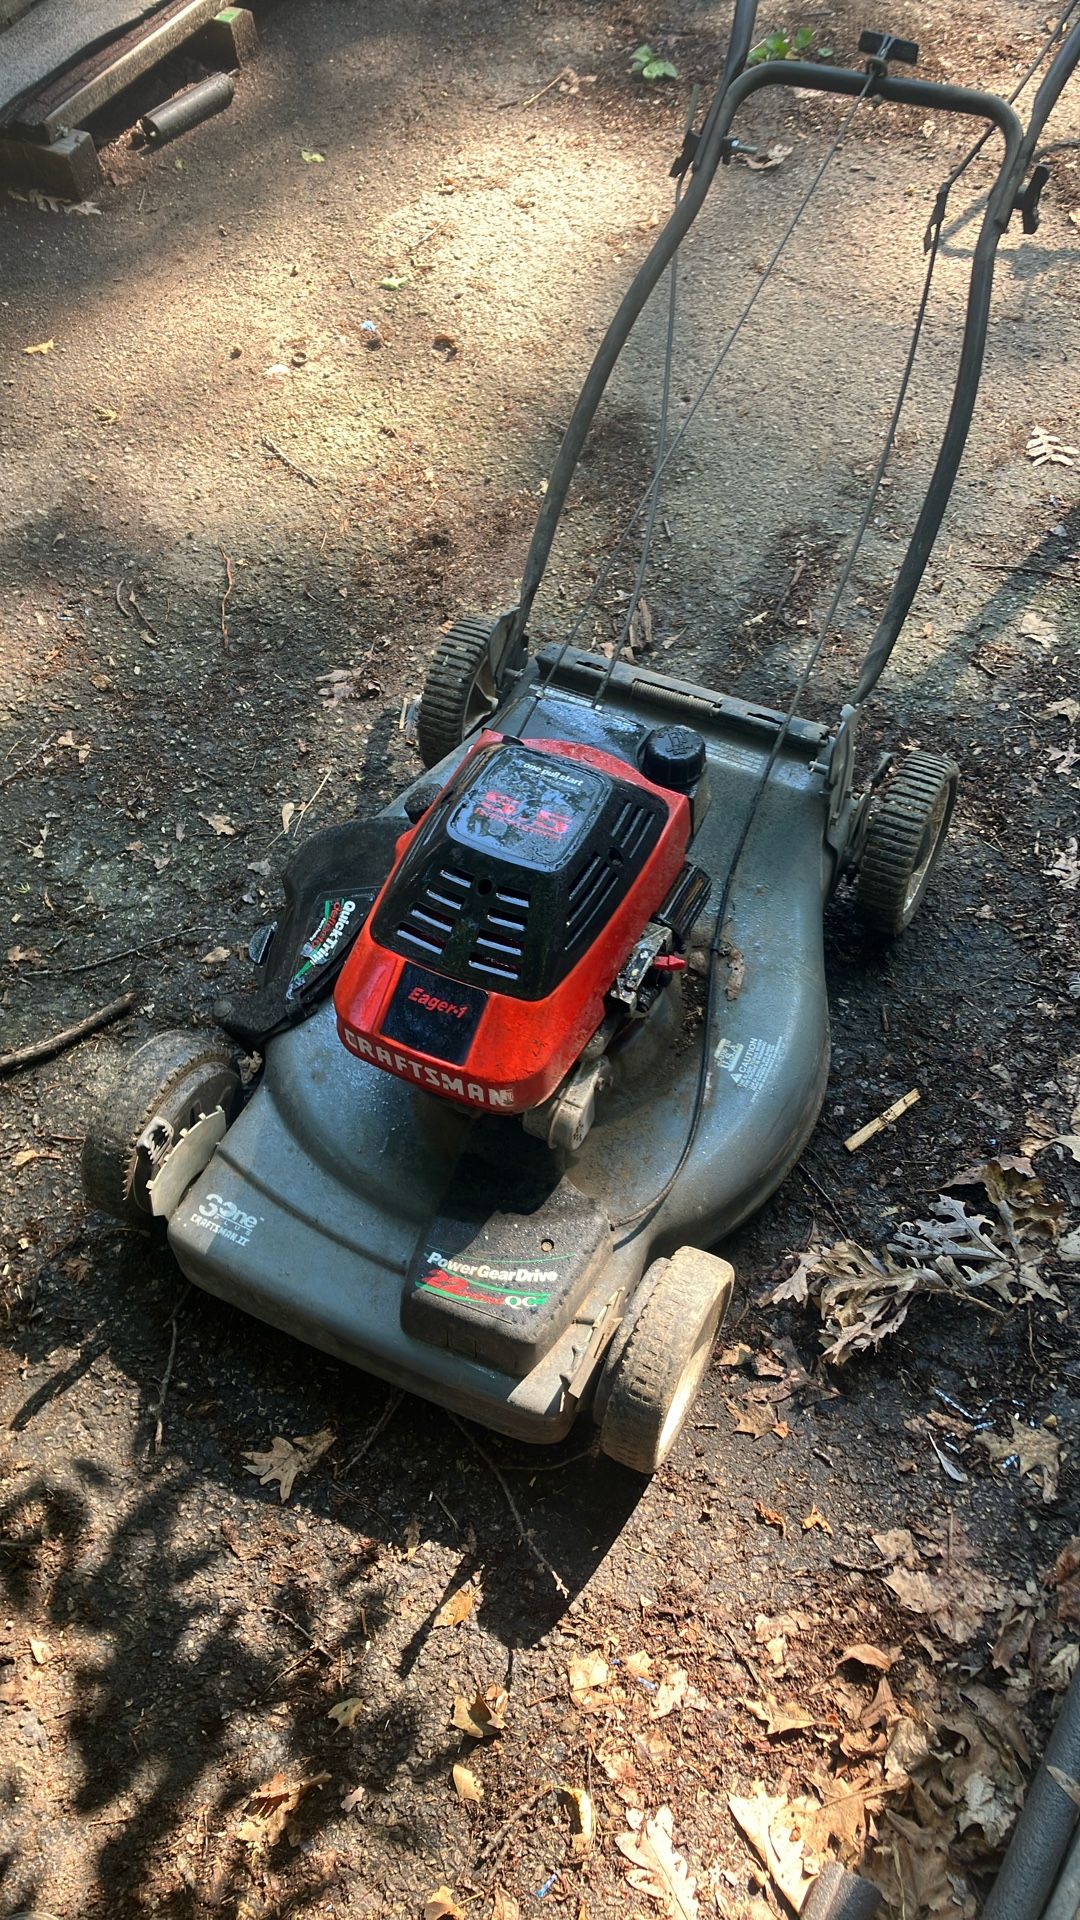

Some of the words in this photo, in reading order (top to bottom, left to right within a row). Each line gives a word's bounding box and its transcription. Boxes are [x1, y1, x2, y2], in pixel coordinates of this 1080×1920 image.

[523, 762, 542, 772] one
[539, 767, 561, 781] pull
[559, 773, 584, 787] start
[344, 1028, 514, 1107] CRAFTSMAN
[739, 1037, 758, 1073] CAUTION
[190, 1213, 239, 1242] CRAFTSMAN
[505, 1295, 539, 1310] QC
